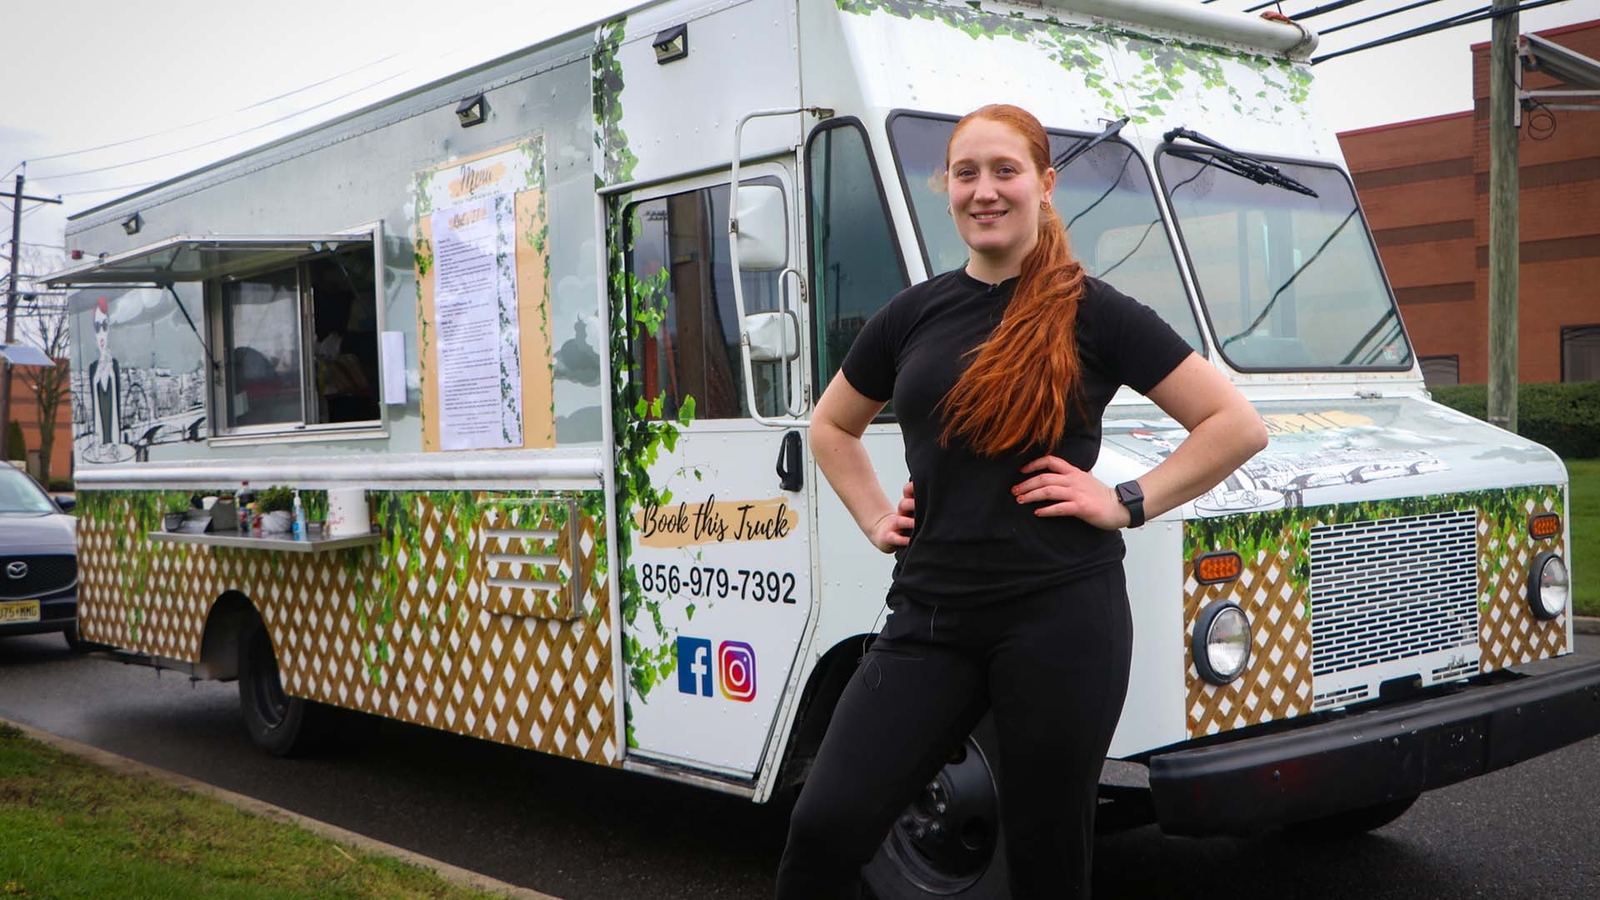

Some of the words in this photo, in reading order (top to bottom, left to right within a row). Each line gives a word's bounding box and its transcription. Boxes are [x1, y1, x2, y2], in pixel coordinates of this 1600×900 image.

[460, 164, 493, 196] Menu
[643, 501, 690, 538] Book
[692, 493, 729, 542] this
[734, 503, 790, 540] Truck
[642, 563, 797, 604] 856-979-7392
